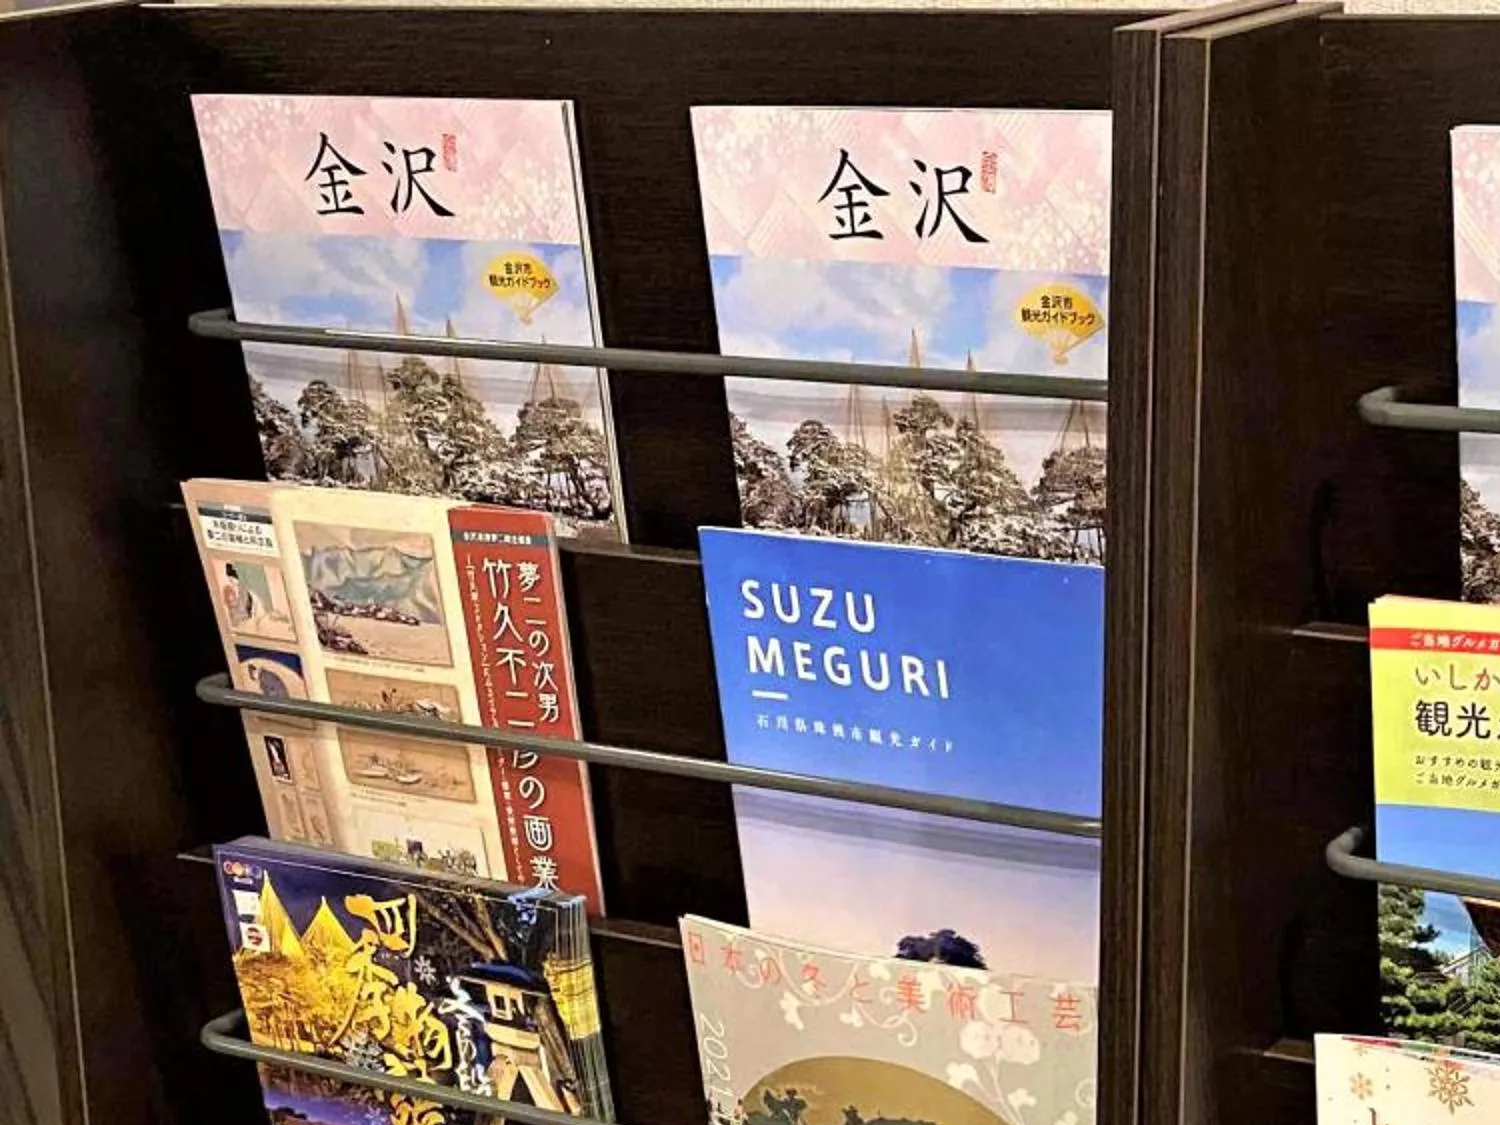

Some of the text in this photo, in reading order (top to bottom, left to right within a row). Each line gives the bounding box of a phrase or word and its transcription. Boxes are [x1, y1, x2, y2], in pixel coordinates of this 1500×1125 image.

[305, 131, 455, 217] 金沢
[817, 148, 989, 243] 金沢
[1020, 309, 1097, 326] 観光ガイドブック
[1040, 294, 1074, 310] 金沢市
[741, 579, 876, 632] SUZU
[516, 560, 559, 722] 夢二の次男
[747, 635, 950, 698] MEGURI
